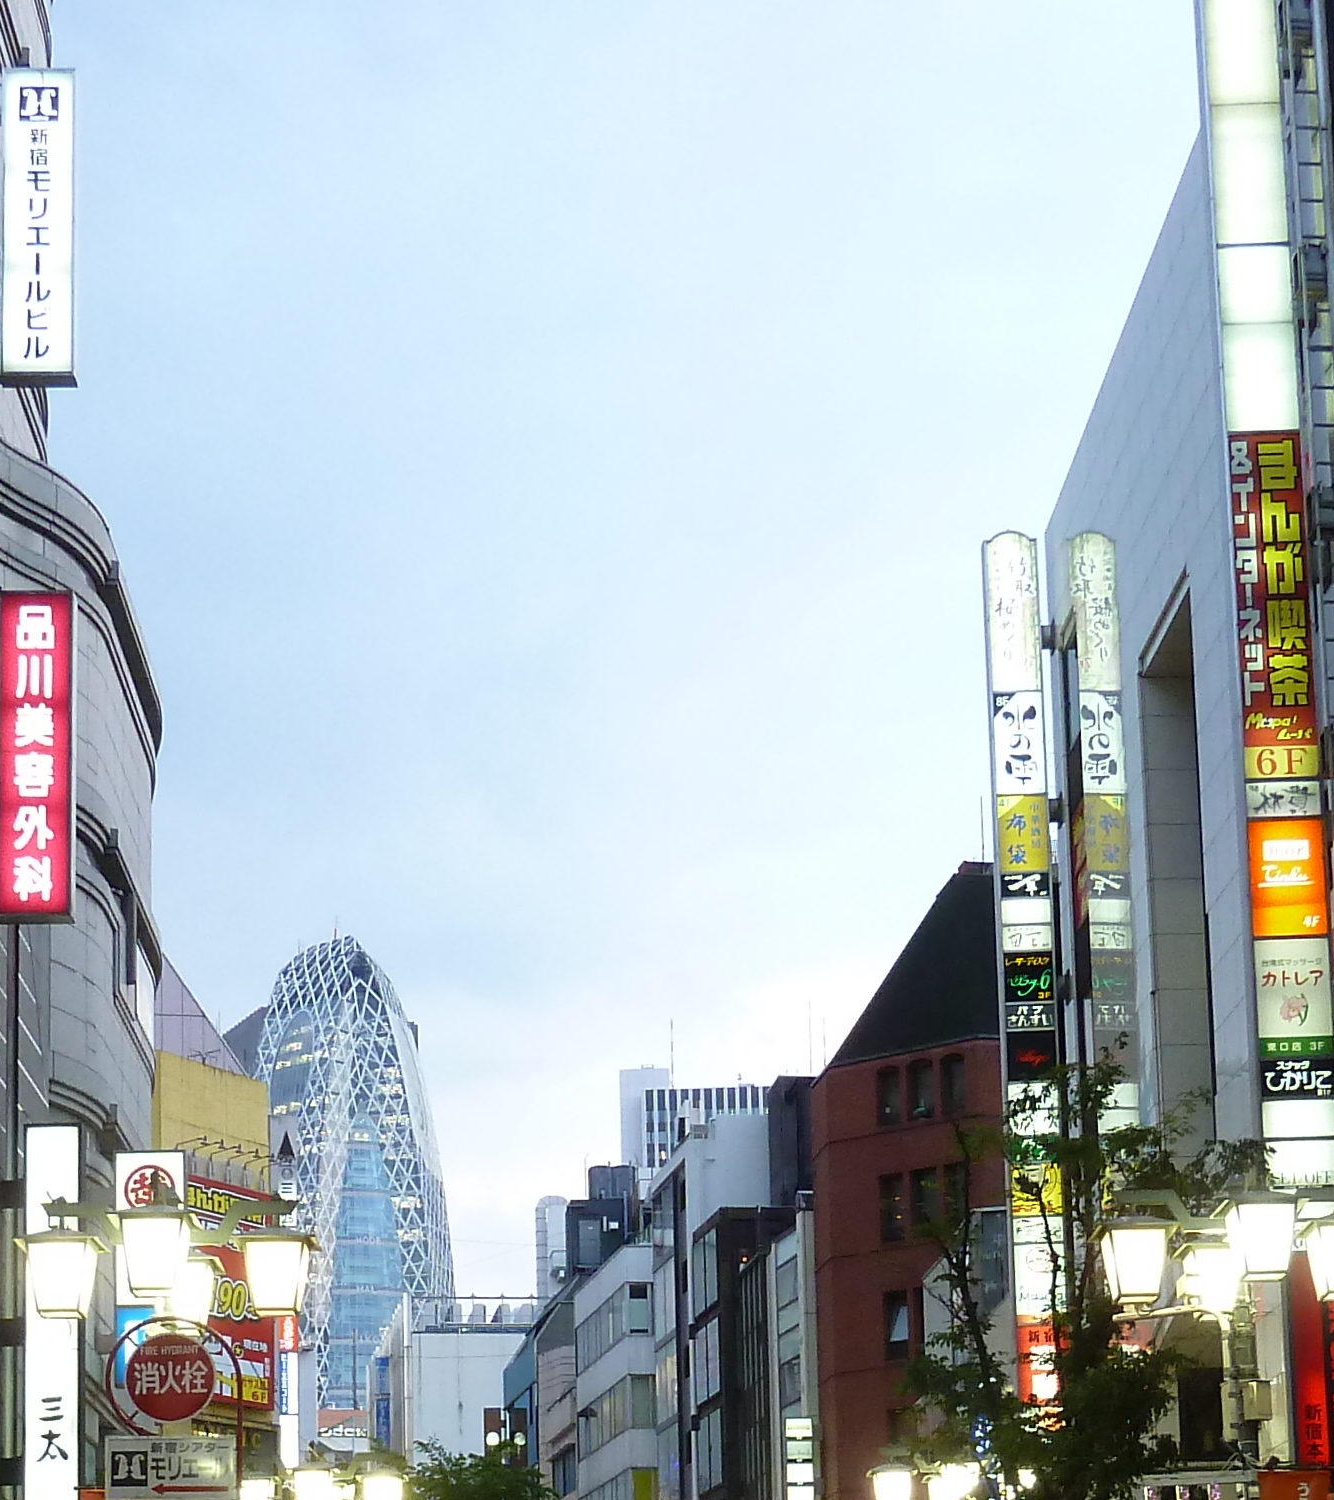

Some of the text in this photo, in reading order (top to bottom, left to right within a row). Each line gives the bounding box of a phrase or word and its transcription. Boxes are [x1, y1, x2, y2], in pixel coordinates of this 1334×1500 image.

[21, 126, 53, 359] 新宿モリエールビル
[1256, 438, 1310, 708] まんが喫茶
[12, 604, 56, 902] 品川美容外科
[1255, 747, 1308, 776] 6F
[1261, 968, 1325, 988] カトレア
[1309, 1041, 1326, 1052] 3F
[1275, 1059, 1311, 1071] スナック
[139, 1344, 200, 1357] FIRE HYDRANT
[133, 1360, 209, 1396] 消火栓
[37, 1395, 70, 1463] 三太
[1304, 1401, 1325, 1466] 新宿本
[150, 1441, 231, 1454] 新宿シアター
[150, 1455, 230, 1481] モリエール
